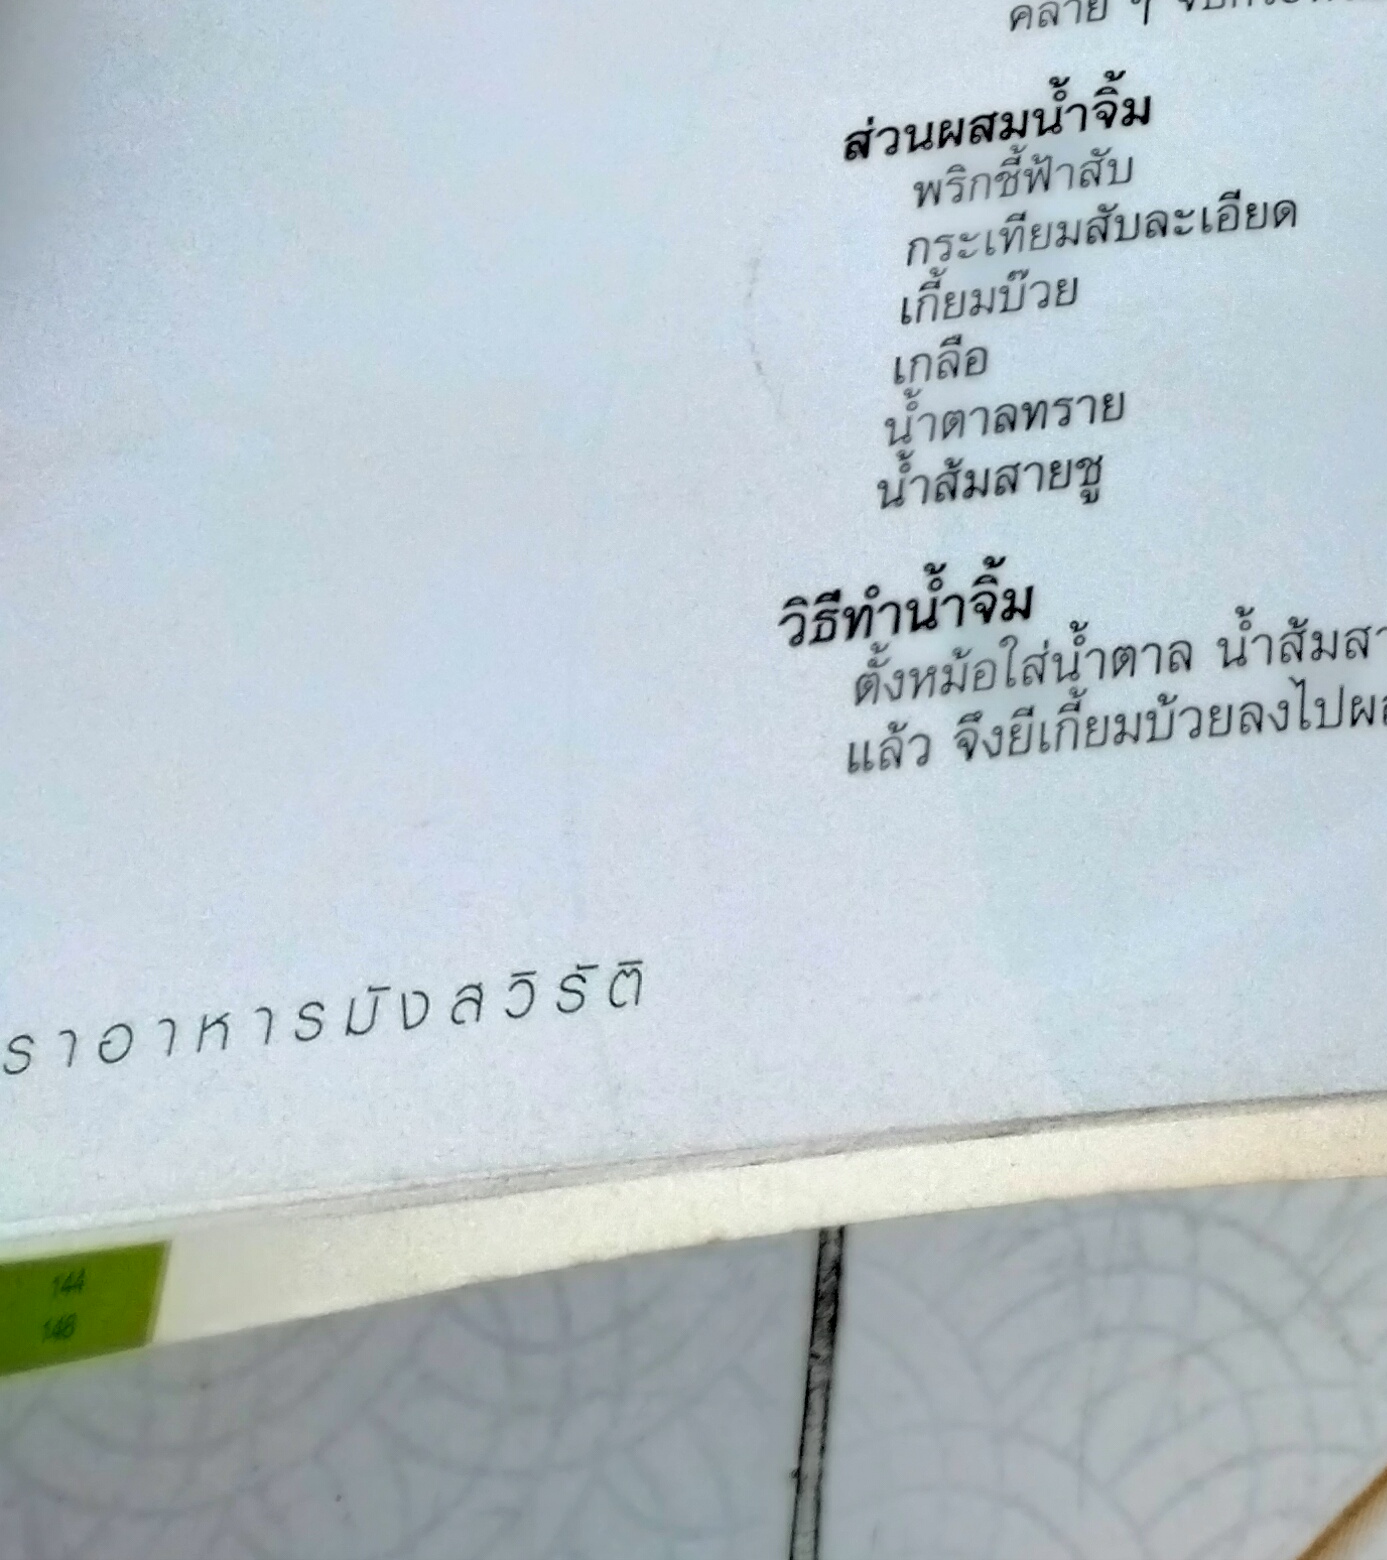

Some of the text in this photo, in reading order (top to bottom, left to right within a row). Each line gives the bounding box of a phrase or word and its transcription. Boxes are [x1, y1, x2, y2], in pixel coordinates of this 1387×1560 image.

[843, 70, 1152, 162] ส่วนผสมน้ำจิ้ม
[913, 143, 1134, 208] พริกชี้ฟ้าสับ
[906, 189, 1298, 267] กระเทียมสับละเอียด
[900, 267, 1080, 326] เกี้ยมบ๊วย
[893, 334, 989, 387] เกลือ
[884, 387, 1126, 448] น้ำตาลทราย
[876, 448, 1104, 510] น้ำส้มสายชู
[778, 555, 1034, 649] วิธีทำน้ำจิ้ม
[853, 619, 1194, 708] ตั้งหม้อใส่น้ำตาล
[847, 721, 931, 775] แล้ว
